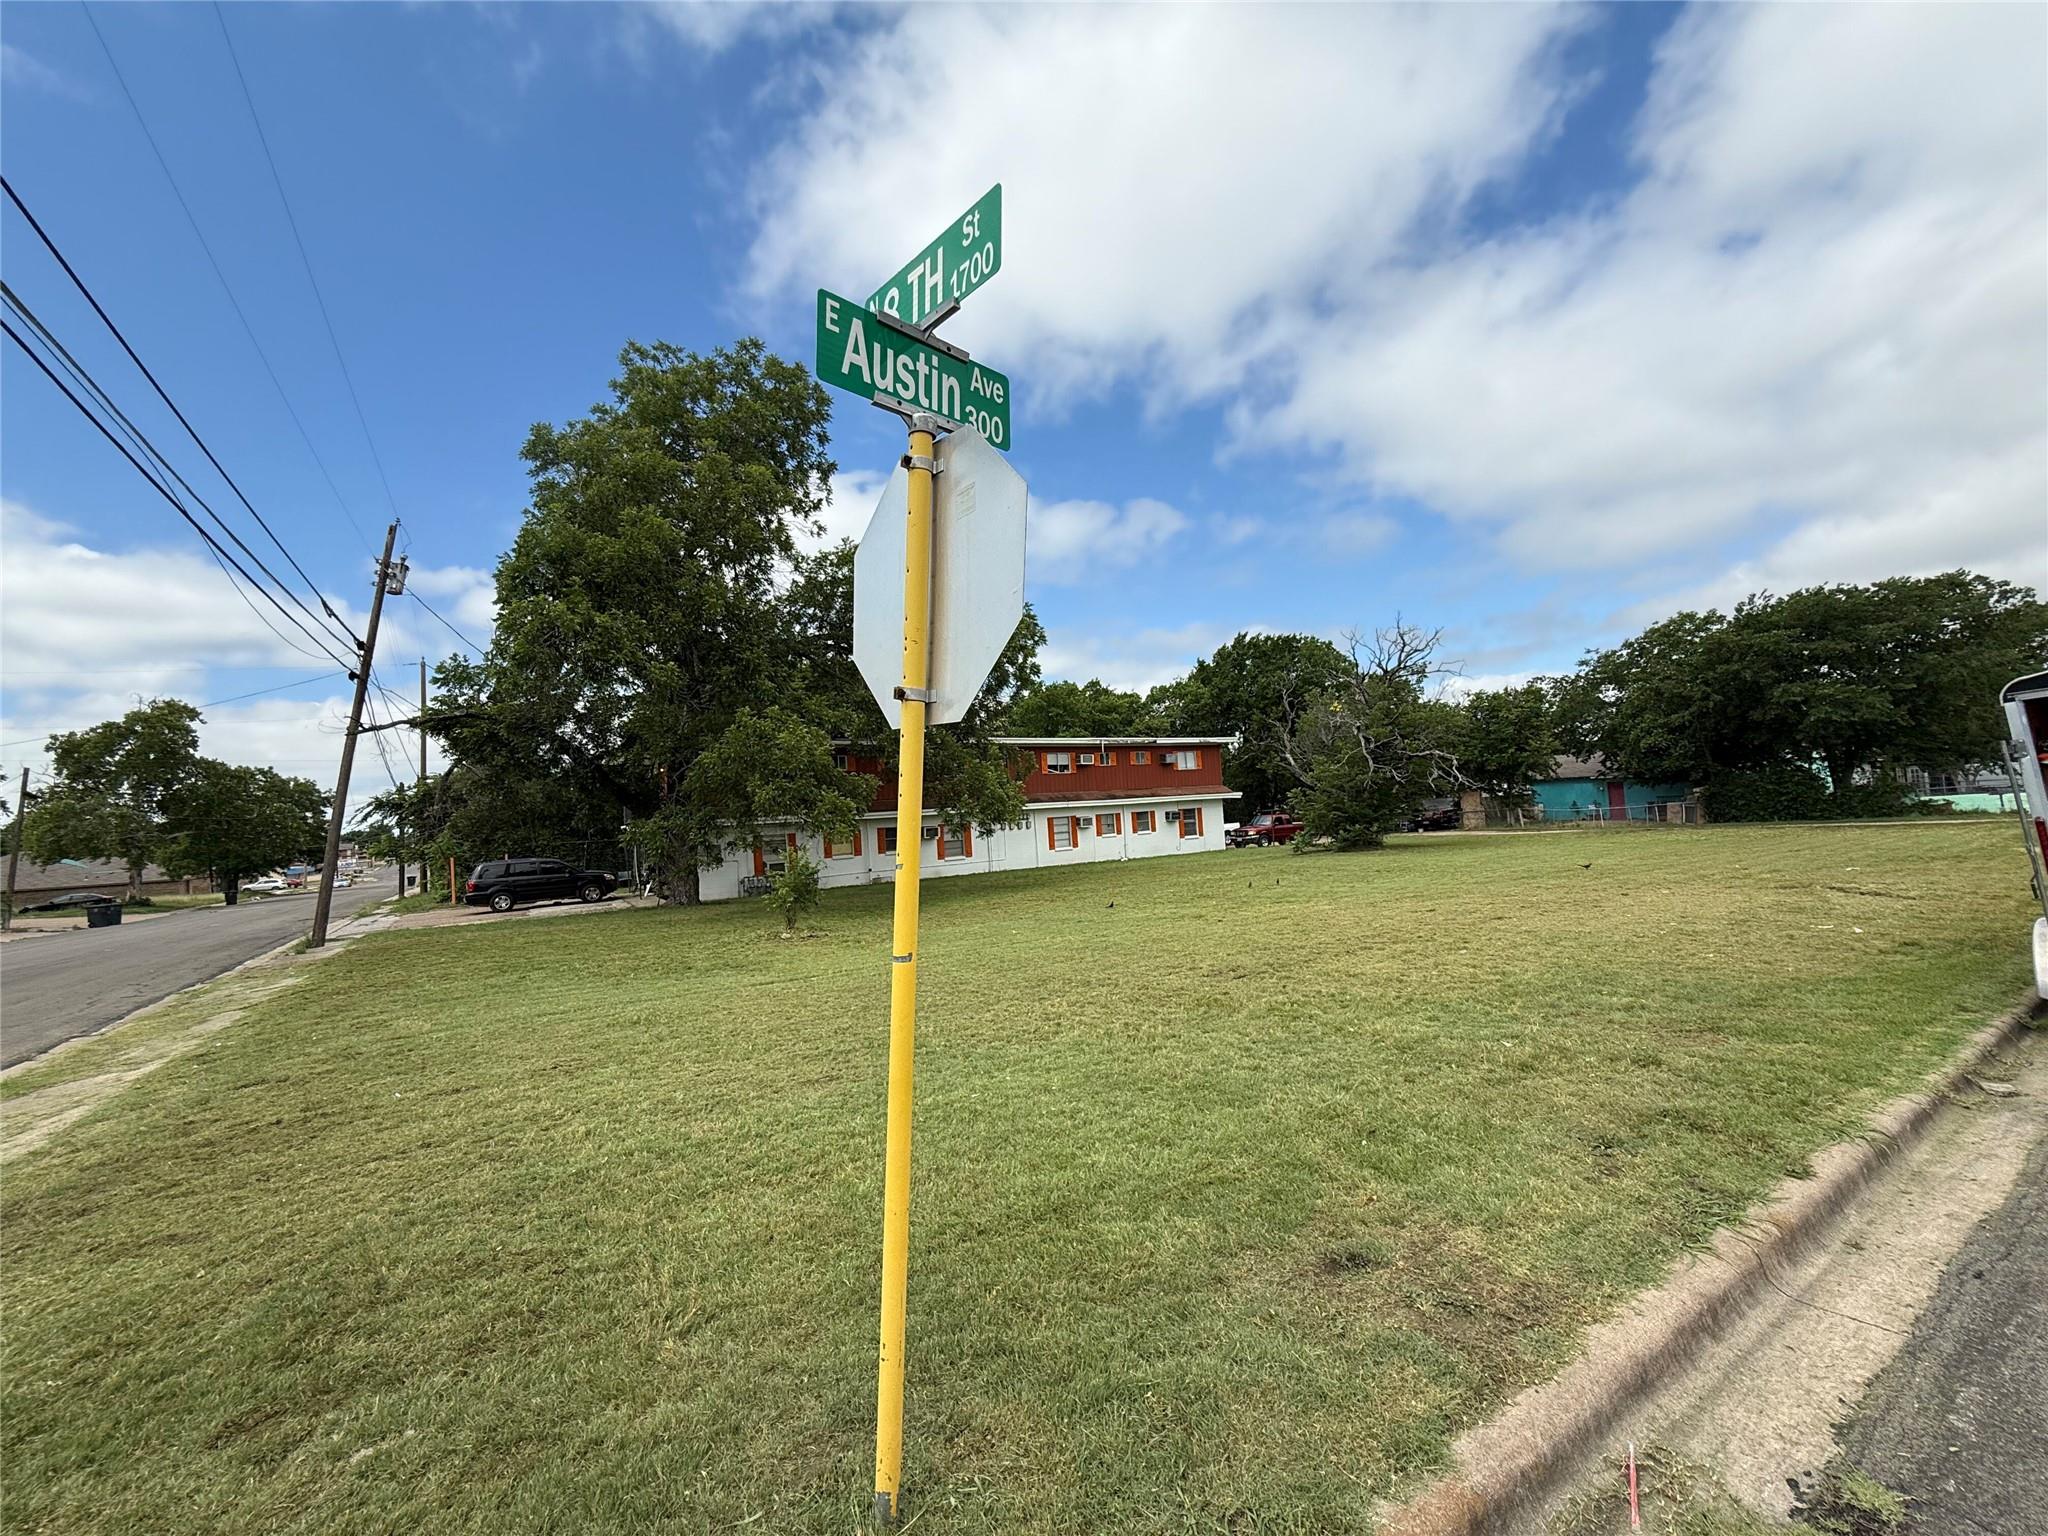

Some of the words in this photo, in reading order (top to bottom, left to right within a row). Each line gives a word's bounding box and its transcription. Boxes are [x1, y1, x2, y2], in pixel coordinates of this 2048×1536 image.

[907, 246, 944, 325] TH
[962, 209, 980, 247] St
[950, 241, 994, 298] 1700
[825, 297, 840, 333] E
[841, 317, 961, 421] Austin
[970, 366, 1004, 404] Ave
[965, 405, 1004, 444] 300
